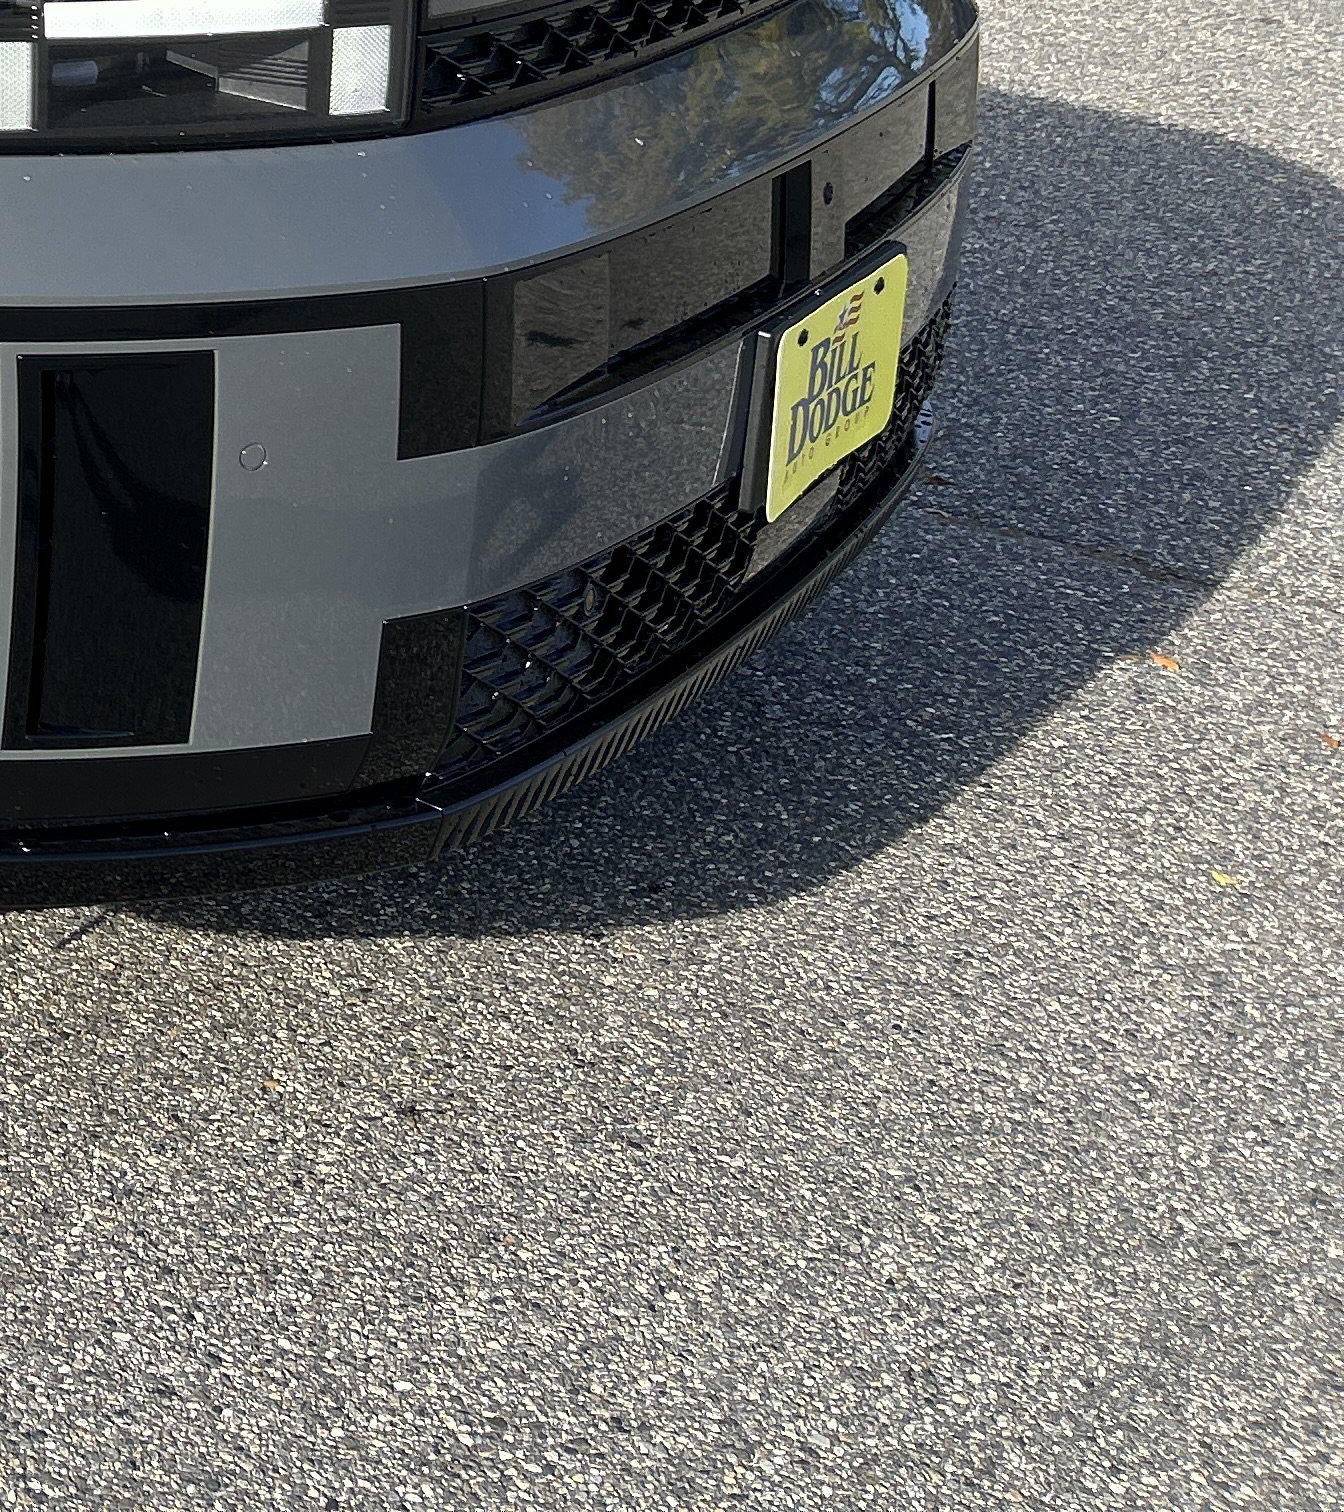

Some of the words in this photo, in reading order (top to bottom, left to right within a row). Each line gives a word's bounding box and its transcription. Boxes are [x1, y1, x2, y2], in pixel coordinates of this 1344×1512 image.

[808, 331, 864, 403] BILL
[783, 444, 816, 486] AUTO
[824, 405, 870, 448] GROUP
[785, 360, 877, 467] DODGE
